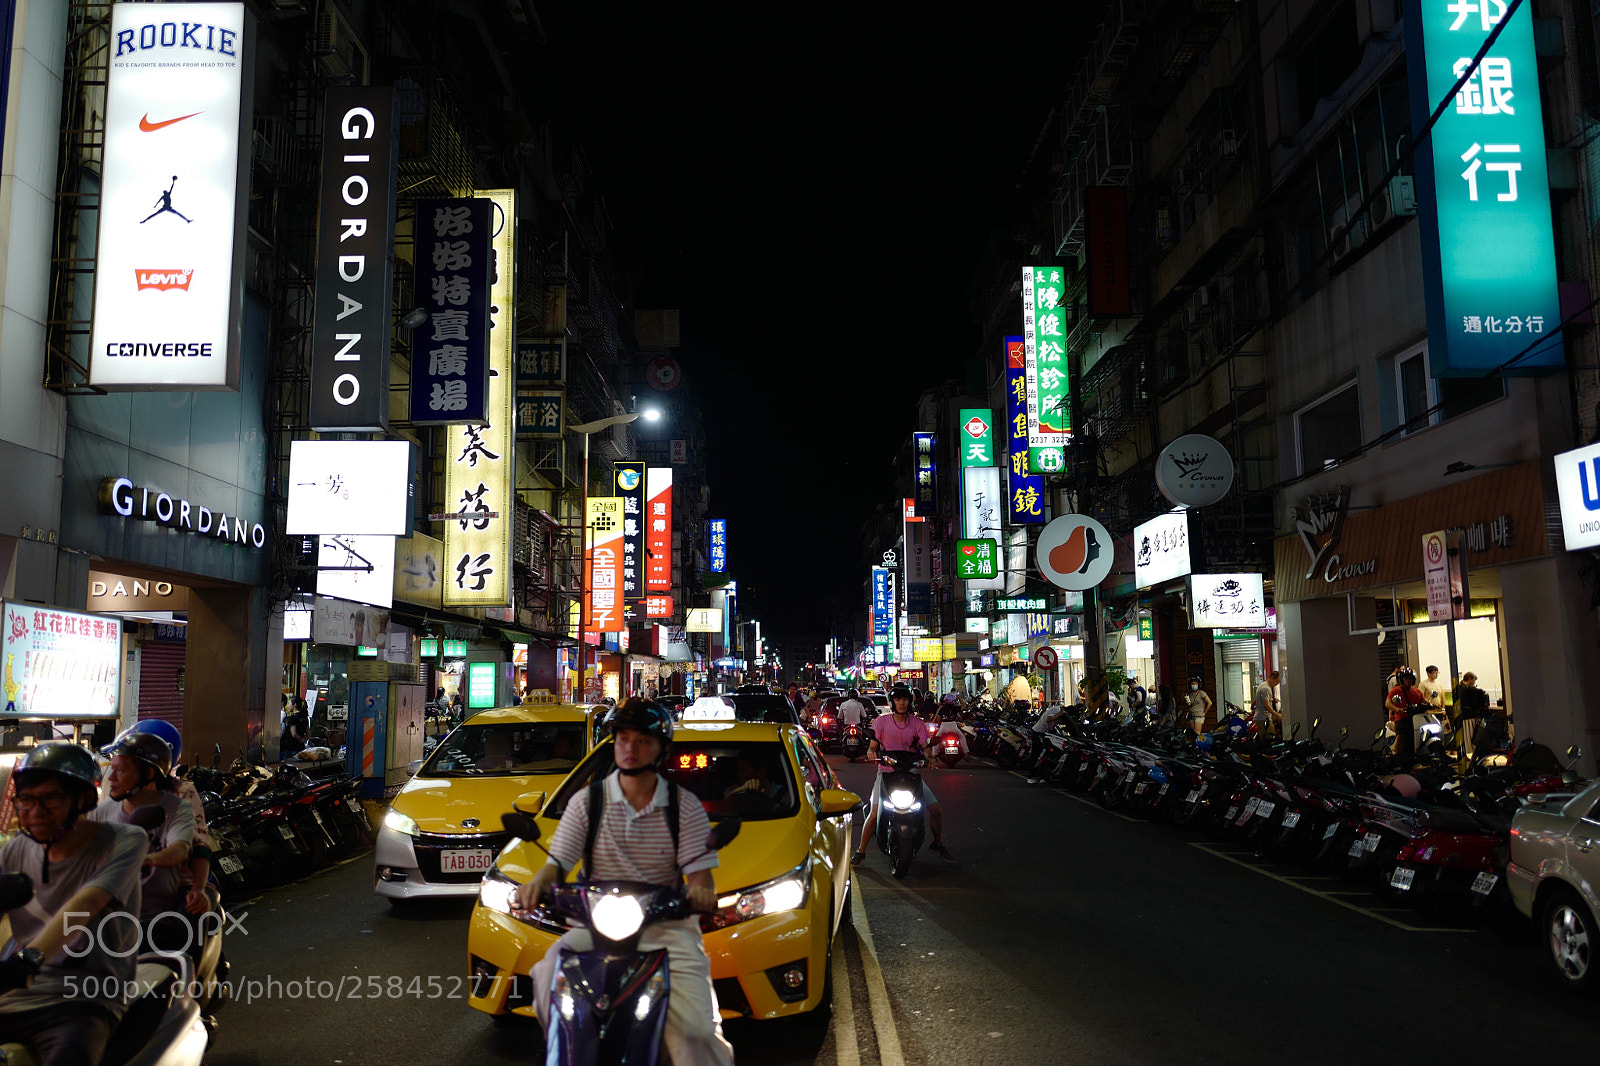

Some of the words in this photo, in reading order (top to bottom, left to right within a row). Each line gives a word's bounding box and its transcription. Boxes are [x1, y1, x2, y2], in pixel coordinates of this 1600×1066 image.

[115, 22, 237, 58] ROOKIE
[332, 106, 376, 406] GIORDANO
[1034, 270, 1060, 284] 長庚
[427, 205, 473, 412] 好好特賣廣場
[1463, 315, 1545, 333] 通化分行
[106, 342, 213, 357] CONVERSE
[519, 349, 560, 374] 磁磚
[1024, 272, 1038, 428] 前台北長庚醫院主治醫師
[1037, 286, 1066, 417] 陳俊松診所
[1011, 375, 1042, 516] 寶島眼鏡
[1031, 436, 1048, 444] 2737
[966, 443, 989, 467] 天
[297, 474, 344, 494] 一芳
[1191, 471, 1225, 481] Crown
[112, 477, 266, 548] GIORDANO
[592, 502, 616, 512] 全國
[712, 521, 725, 572] 環球隱形
[1324, 554, 1376, 583] Crown
[91, 580, 173, 597] DANO
[592, 548, 616, 630] 全國電子
[1141, 620, 1151, 639] 長庚
